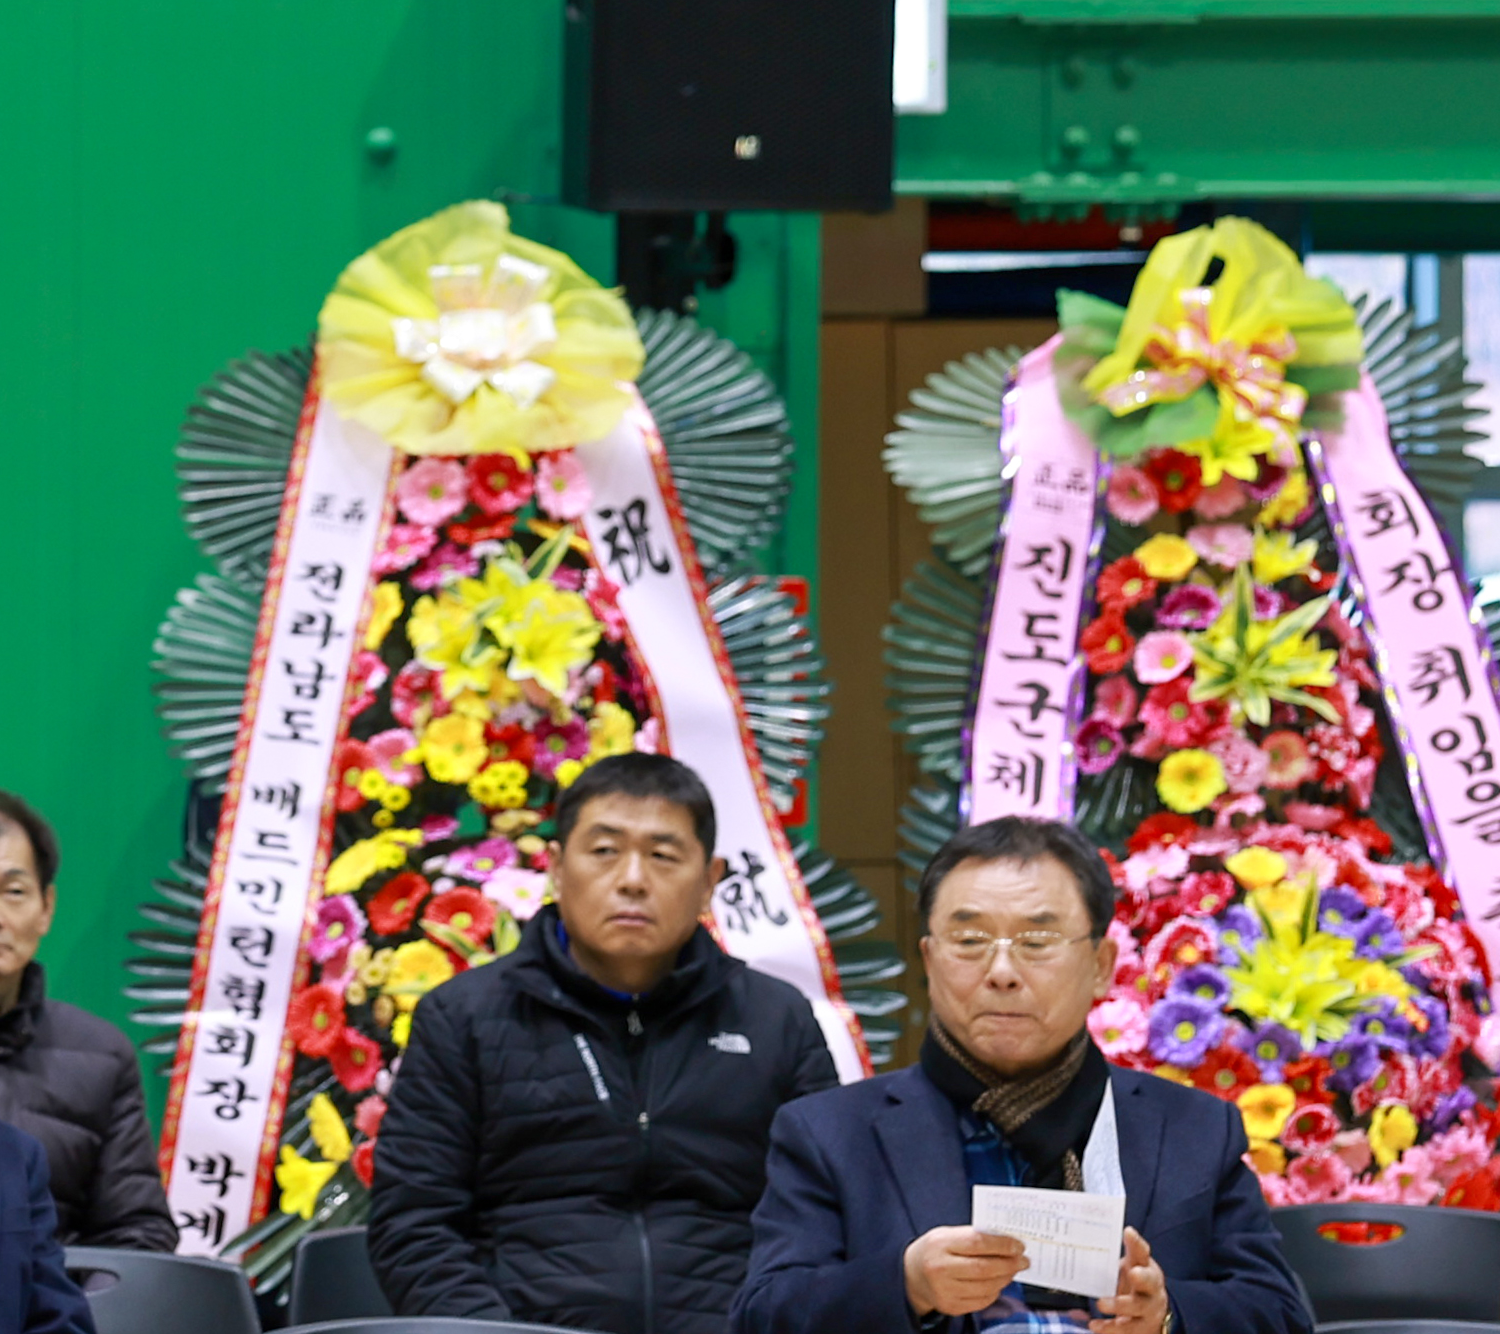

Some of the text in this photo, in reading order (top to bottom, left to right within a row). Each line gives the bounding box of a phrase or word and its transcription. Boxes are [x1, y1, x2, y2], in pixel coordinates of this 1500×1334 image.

[599, 498, 672, 585] 祝
[1354, 492, 1452, 614] 회장
[262, 560, 343, 747] 전라남도
[196, 778, 303, 1125] 배드민턴협회장
